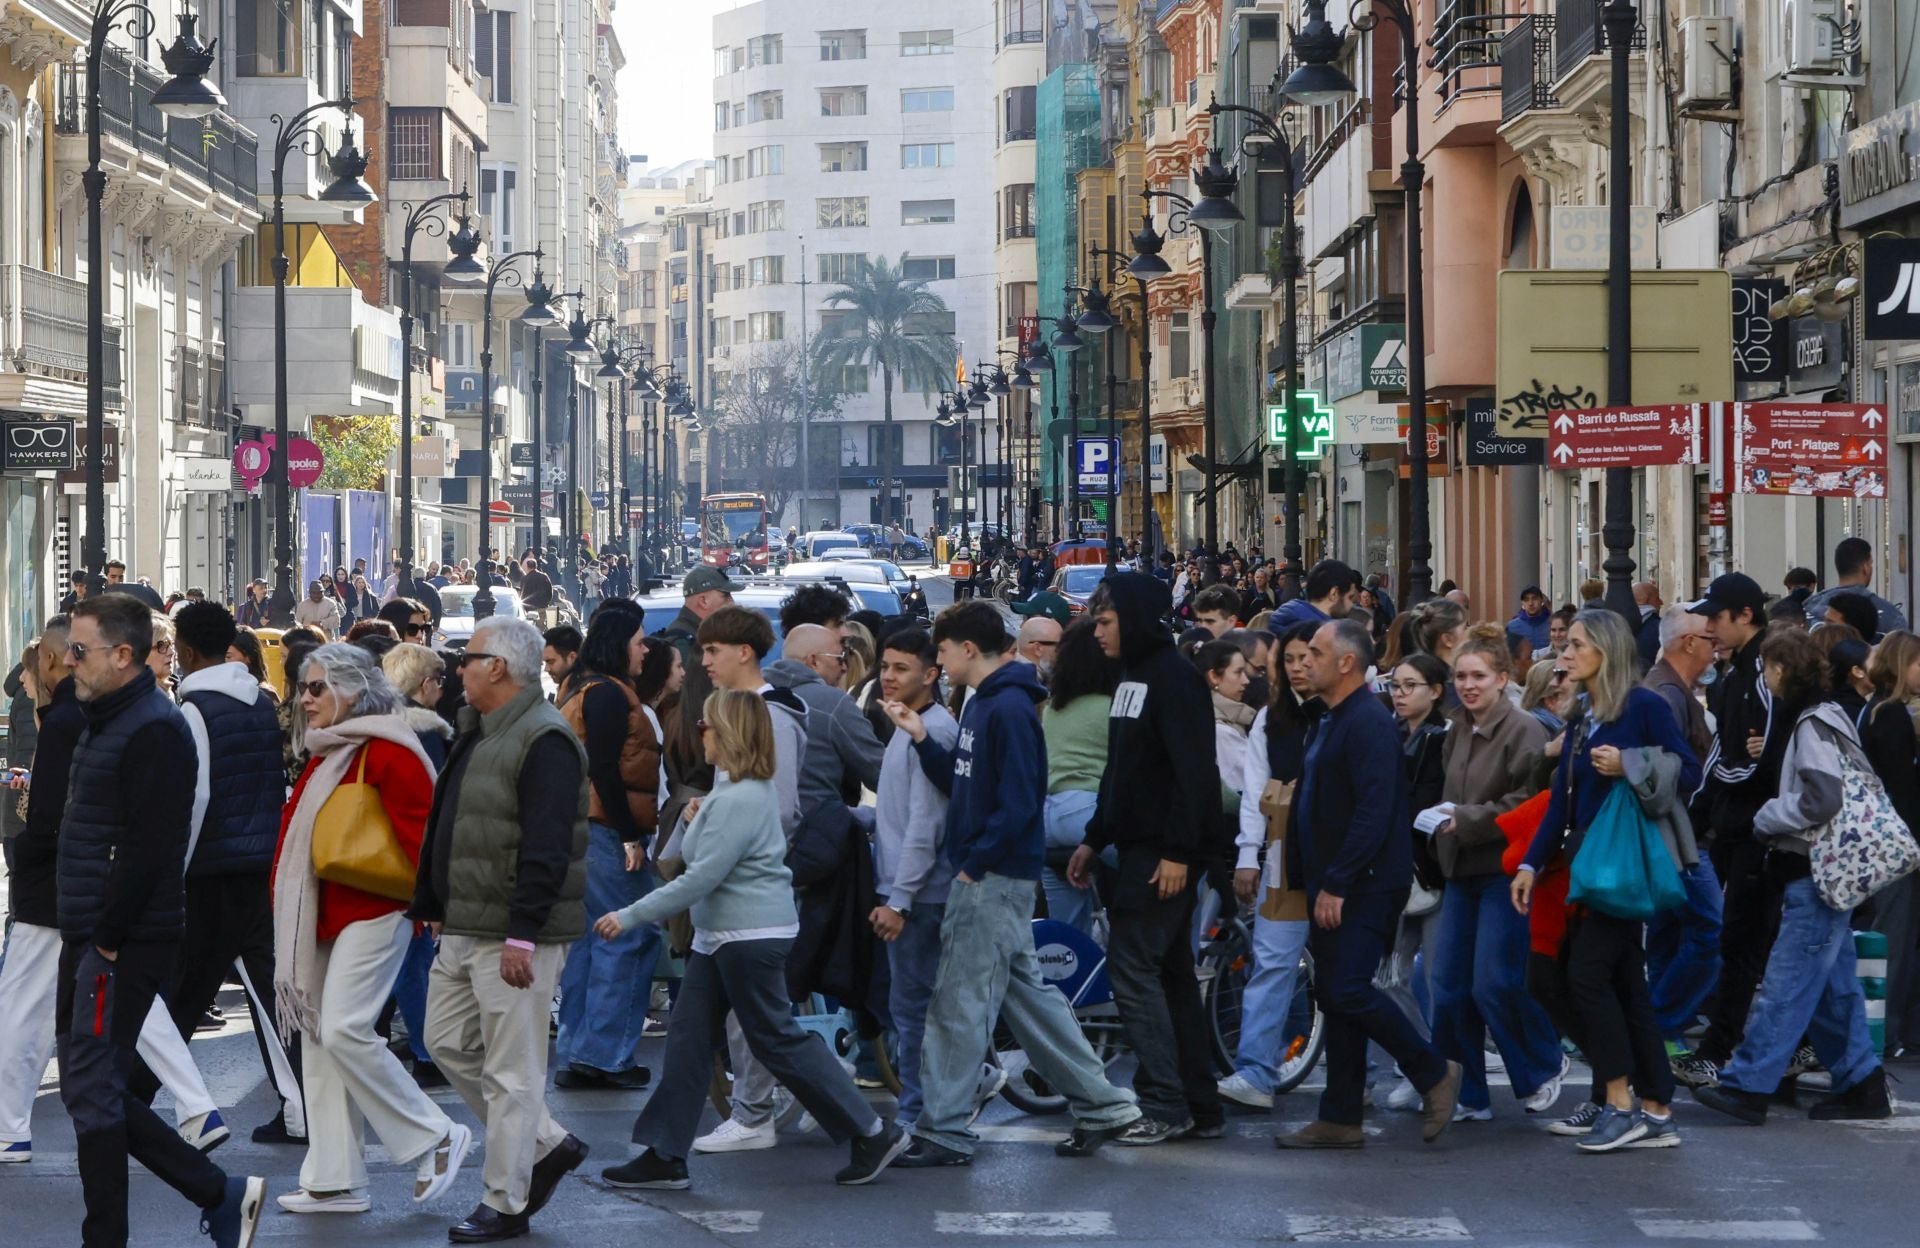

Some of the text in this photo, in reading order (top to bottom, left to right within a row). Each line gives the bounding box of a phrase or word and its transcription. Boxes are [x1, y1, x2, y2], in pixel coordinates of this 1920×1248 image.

[1370, 375, 1407, 386] VAZQ
[1578, 410, 1660, 425] Barri de Russafa
[1476, 440, 1527, 455] Service
[1771, 438, 1792, 449] Port
[1802, 439, 1840, 452] Platges
[288, 458, 319, 470] apoke
